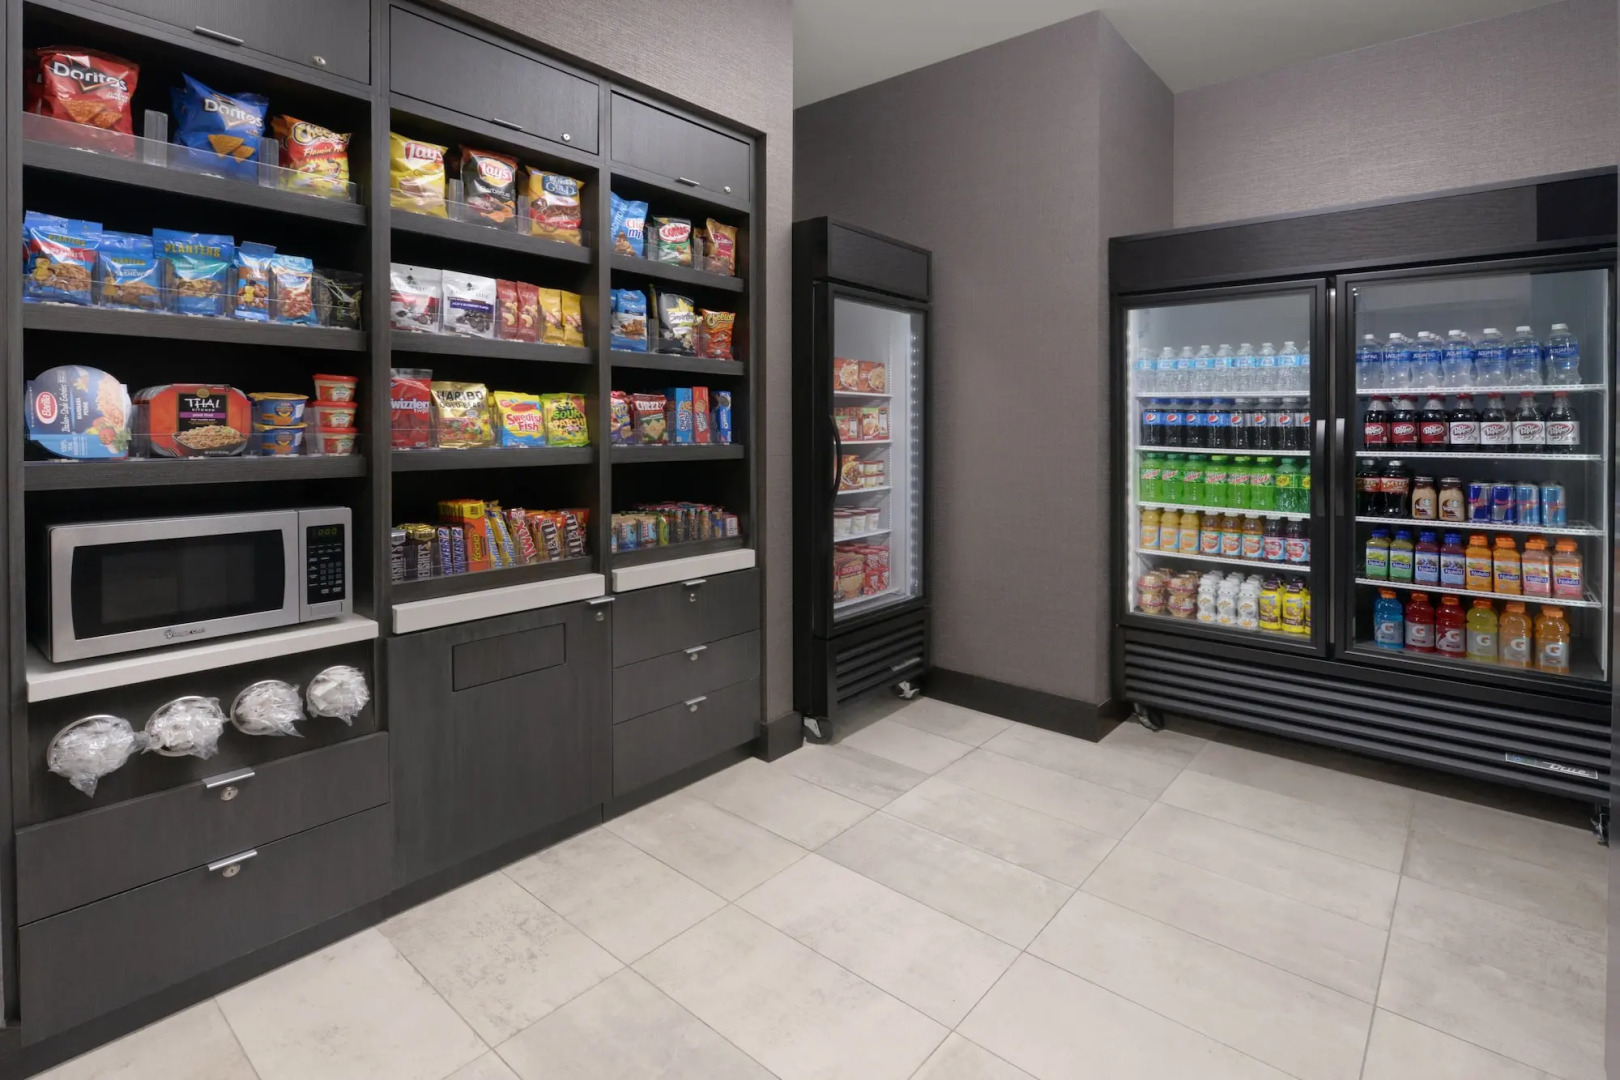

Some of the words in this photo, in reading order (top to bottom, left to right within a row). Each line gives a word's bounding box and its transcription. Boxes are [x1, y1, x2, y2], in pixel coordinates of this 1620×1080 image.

[53, 61, 128, 92] Doritos
[205, 99, 264, 127] Doritos
[164, 243, 221, 258] PLANTERS
[40, 393, 52, 417] Barilla
[184, 398, 220, 409] THAI
[437, 390, 484, 401] HARIBO
[506, 413, 543, 425] Swedish
[517, 421, 539, 432] Fish
[391, 545, 404, 584] ERSHEY'S
[439, 538, 452, 577] SNICKERS
[453, 538, 464, 575] SNICKERS
